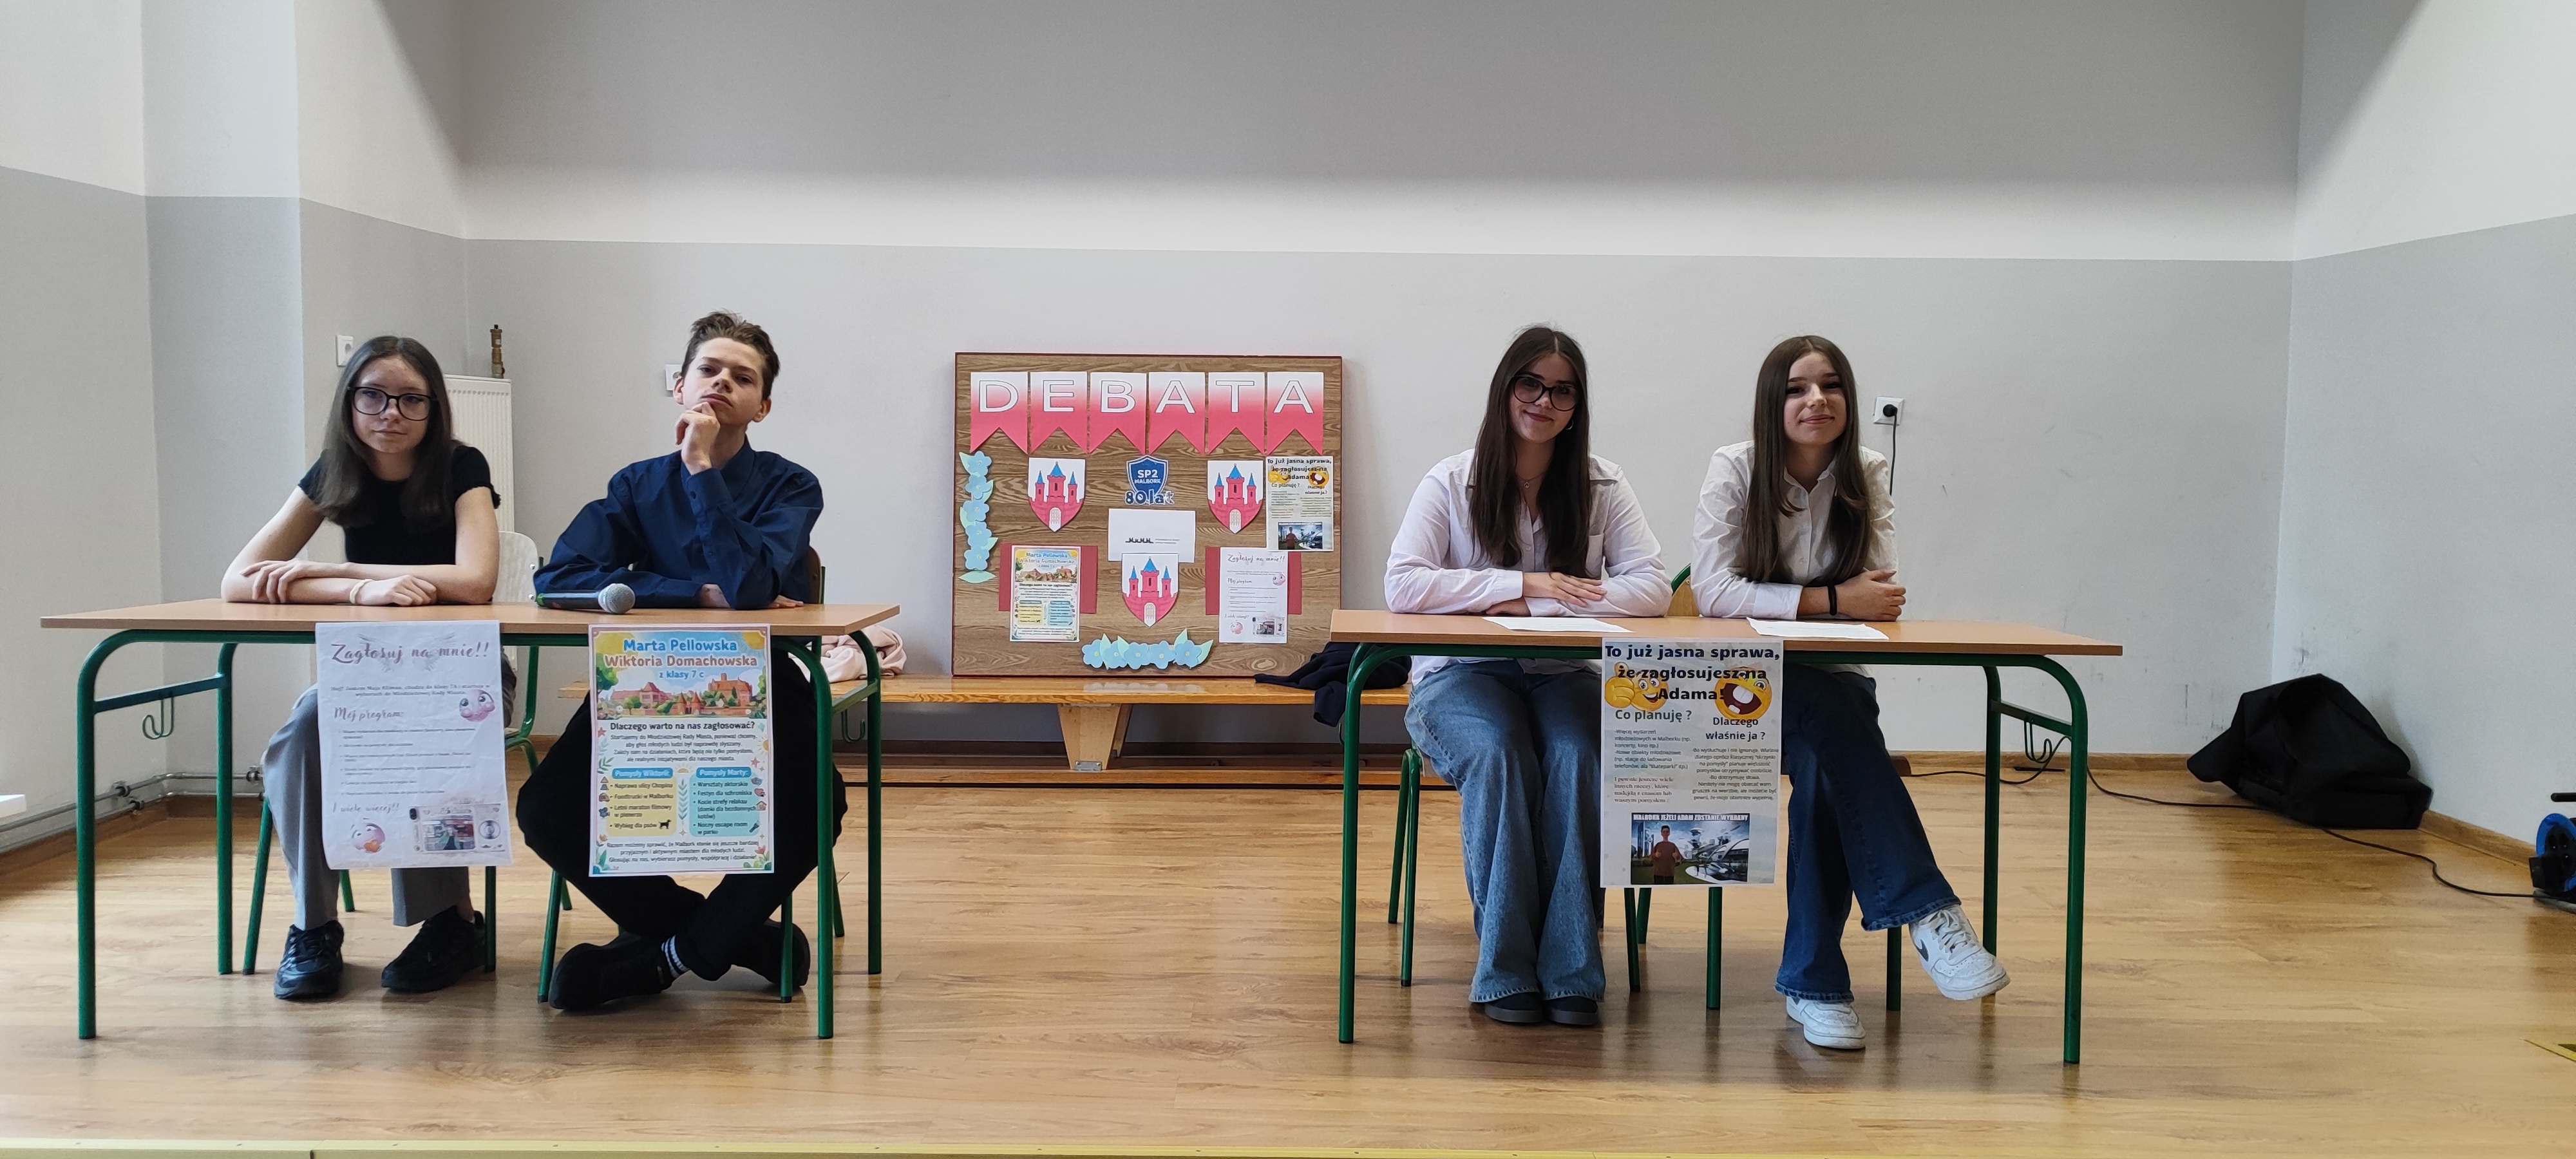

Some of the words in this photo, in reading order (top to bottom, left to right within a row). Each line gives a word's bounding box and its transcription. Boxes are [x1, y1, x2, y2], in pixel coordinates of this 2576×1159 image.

[978, 379, 1314, 414] DEBATA
[1137, 469, 1159, 478] SP2
[1125, 491, 1147, 505] 80
[623, 639, 666, 652] Marta
[670, 639, 737, 652] Pellowska
[331, 643, 403, 664] Zagłosuj
[412, 648, 430, 658] na
[439, 642, 489, 658] mnie!!
[1605, 645, 1622, 657] To
[1627, 644, 1653, 661] już
[1657, 645, 1705, 661] jasna
[1710, 647, 1780, 661] sprawa,
[604, 655, 663, 667] Wiktoria
[667, 655, 757, 667] Domachowska
[667, 670, 689, 680] klasy
[1618, 664, 1635, 679] że
[1642, 666, 1739, 682] zagłosujesz
[1747, 670, 1767, 679] na
[1658, 687, 1725, 701] Adama!
[1615, 709, 1631, 721] Co
[1634, 708, 1682, 722] planuję
[1685, 710, 1692, 721] ?
[610, 722, 647, 732] Dlaczego
[703, 721, 755, 731] zagłosować?
[1713, 717, 1759, 728] Dlaczego
[1705, 730, 1746, 740] właśnie
[1747, 731, 1758, 742] ja
[1760, 731, 1766, 740] ?
